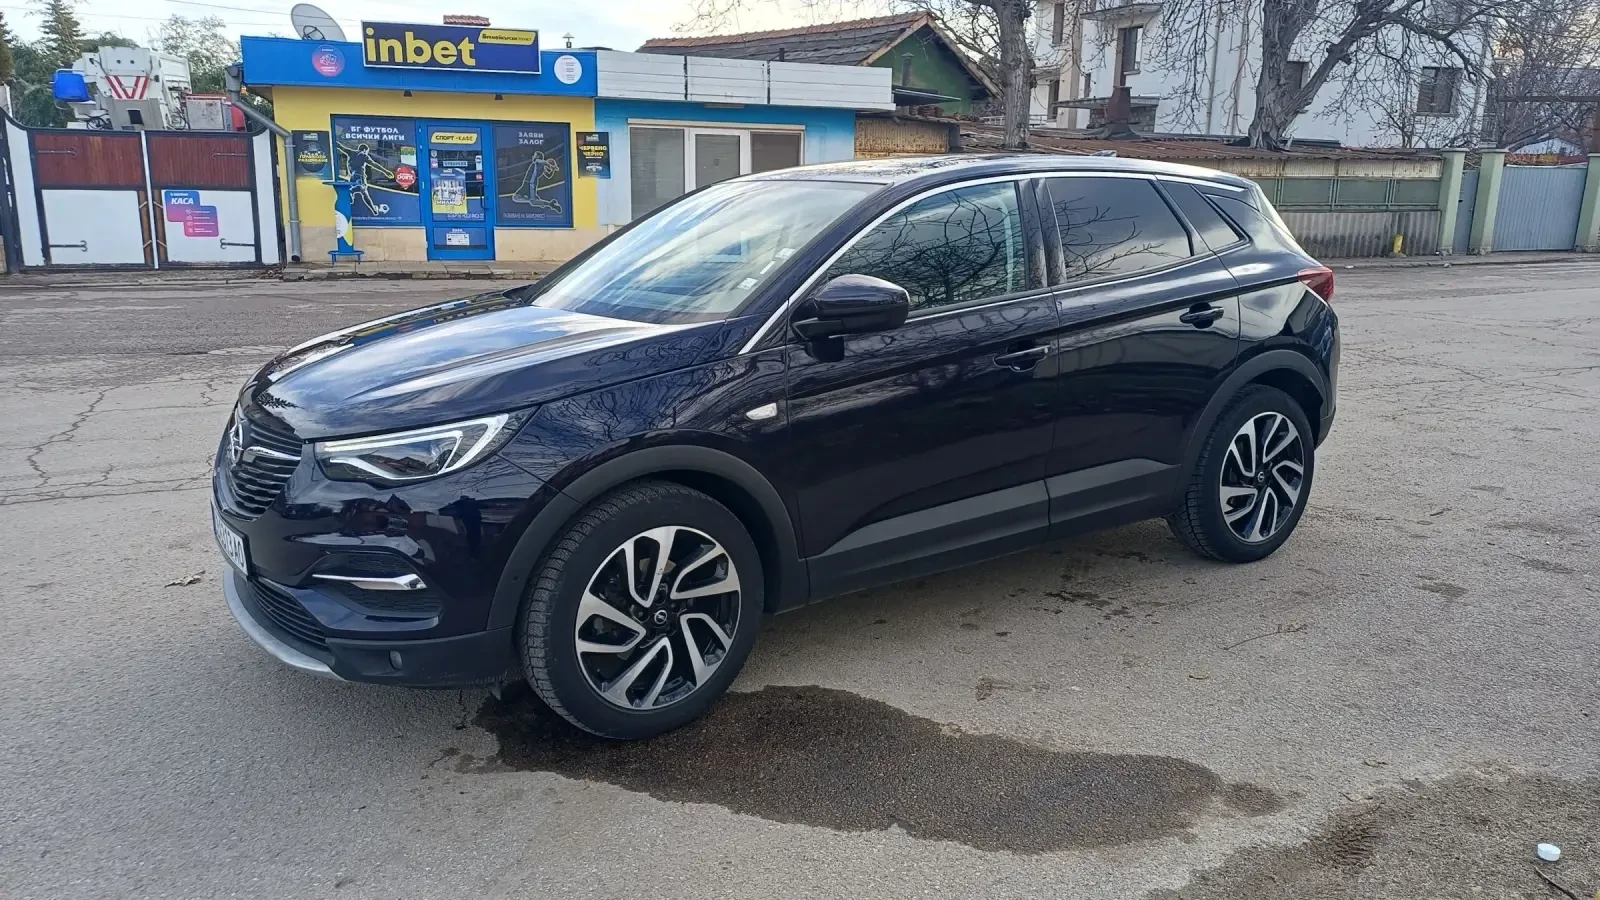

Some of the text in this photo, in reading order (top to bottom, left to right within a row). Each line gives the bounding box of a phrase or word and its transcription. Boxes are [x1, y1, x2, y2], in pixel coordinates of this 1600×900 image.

[365, 27, 476, 66] inbet
[363, 126, 399, 134] ФУТБОЛ
[345, 132, 380, 140] ВСИЧКИ
[171, 197, 194, 205] КАСА
